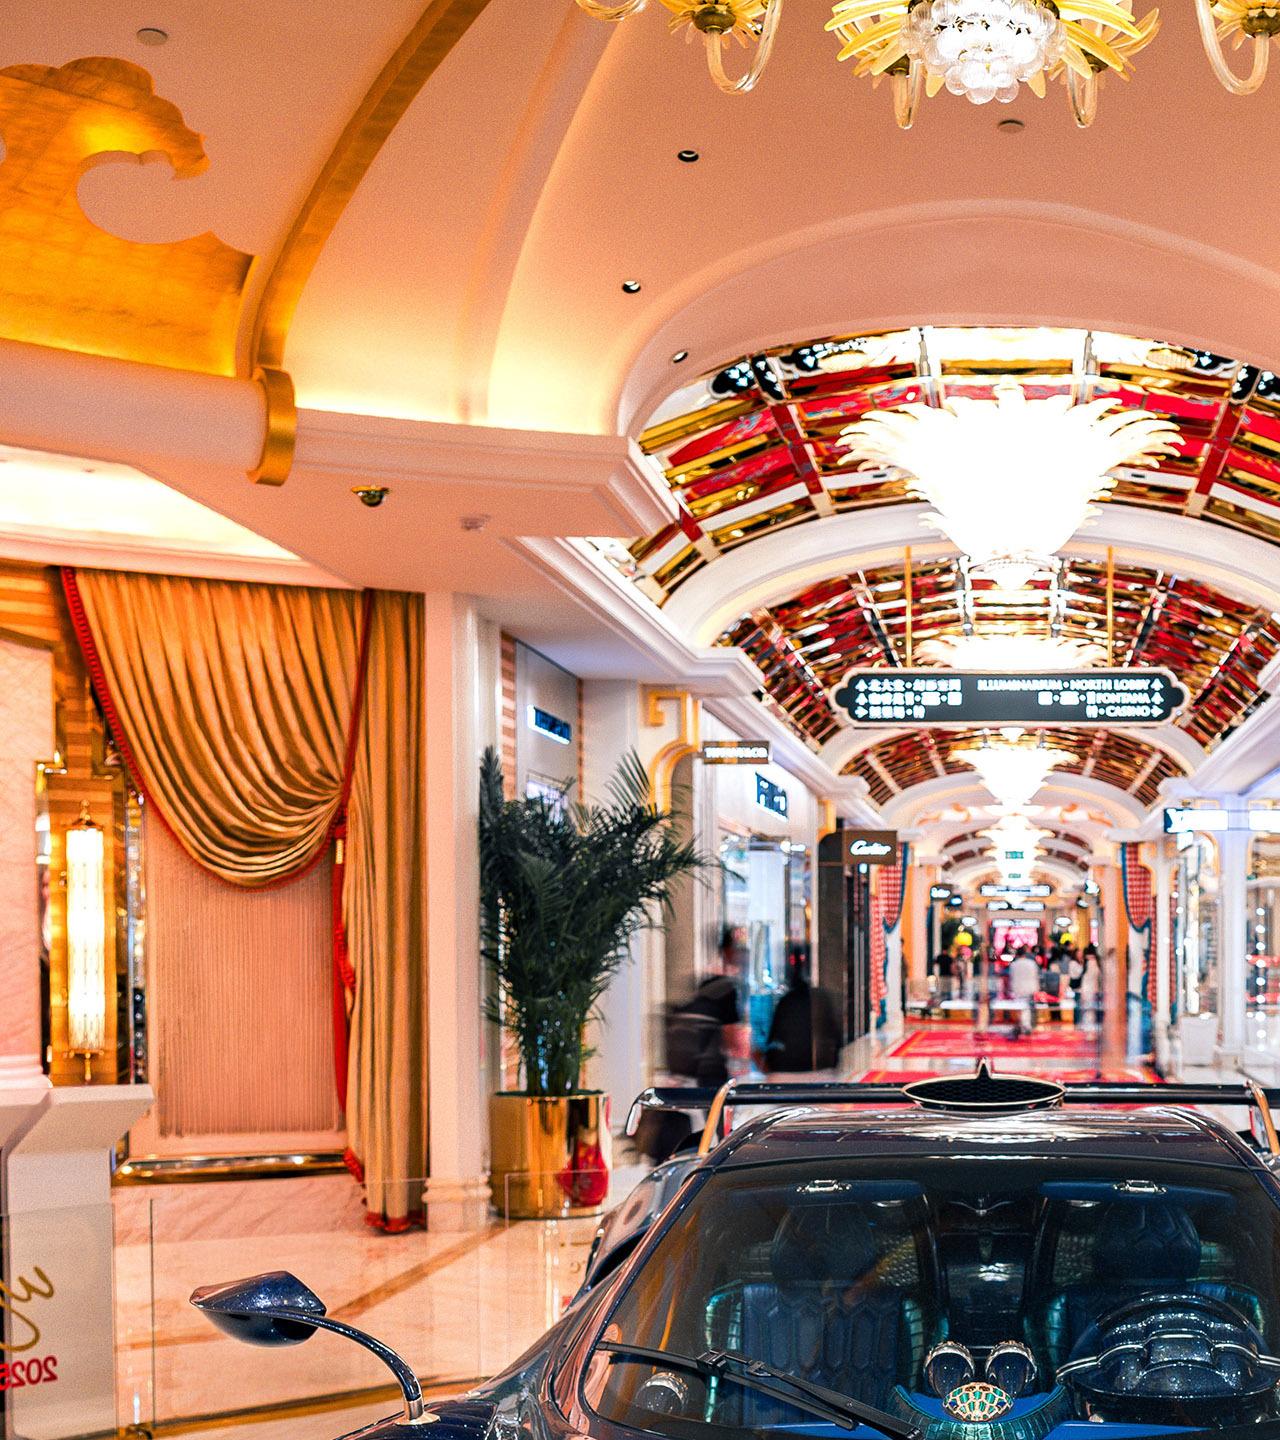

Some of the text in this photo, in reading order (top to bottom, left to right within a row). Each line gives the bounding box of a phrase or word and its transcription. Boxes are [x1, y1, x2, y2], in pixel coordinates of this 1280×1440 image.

[1069, 679, 1113, 691] NORTH
[1113, 679, 1151, 691] LOBBY
[1096, 692, 1151, 704] FONTANA
[1105, 705, 1151, 717] CASINO
